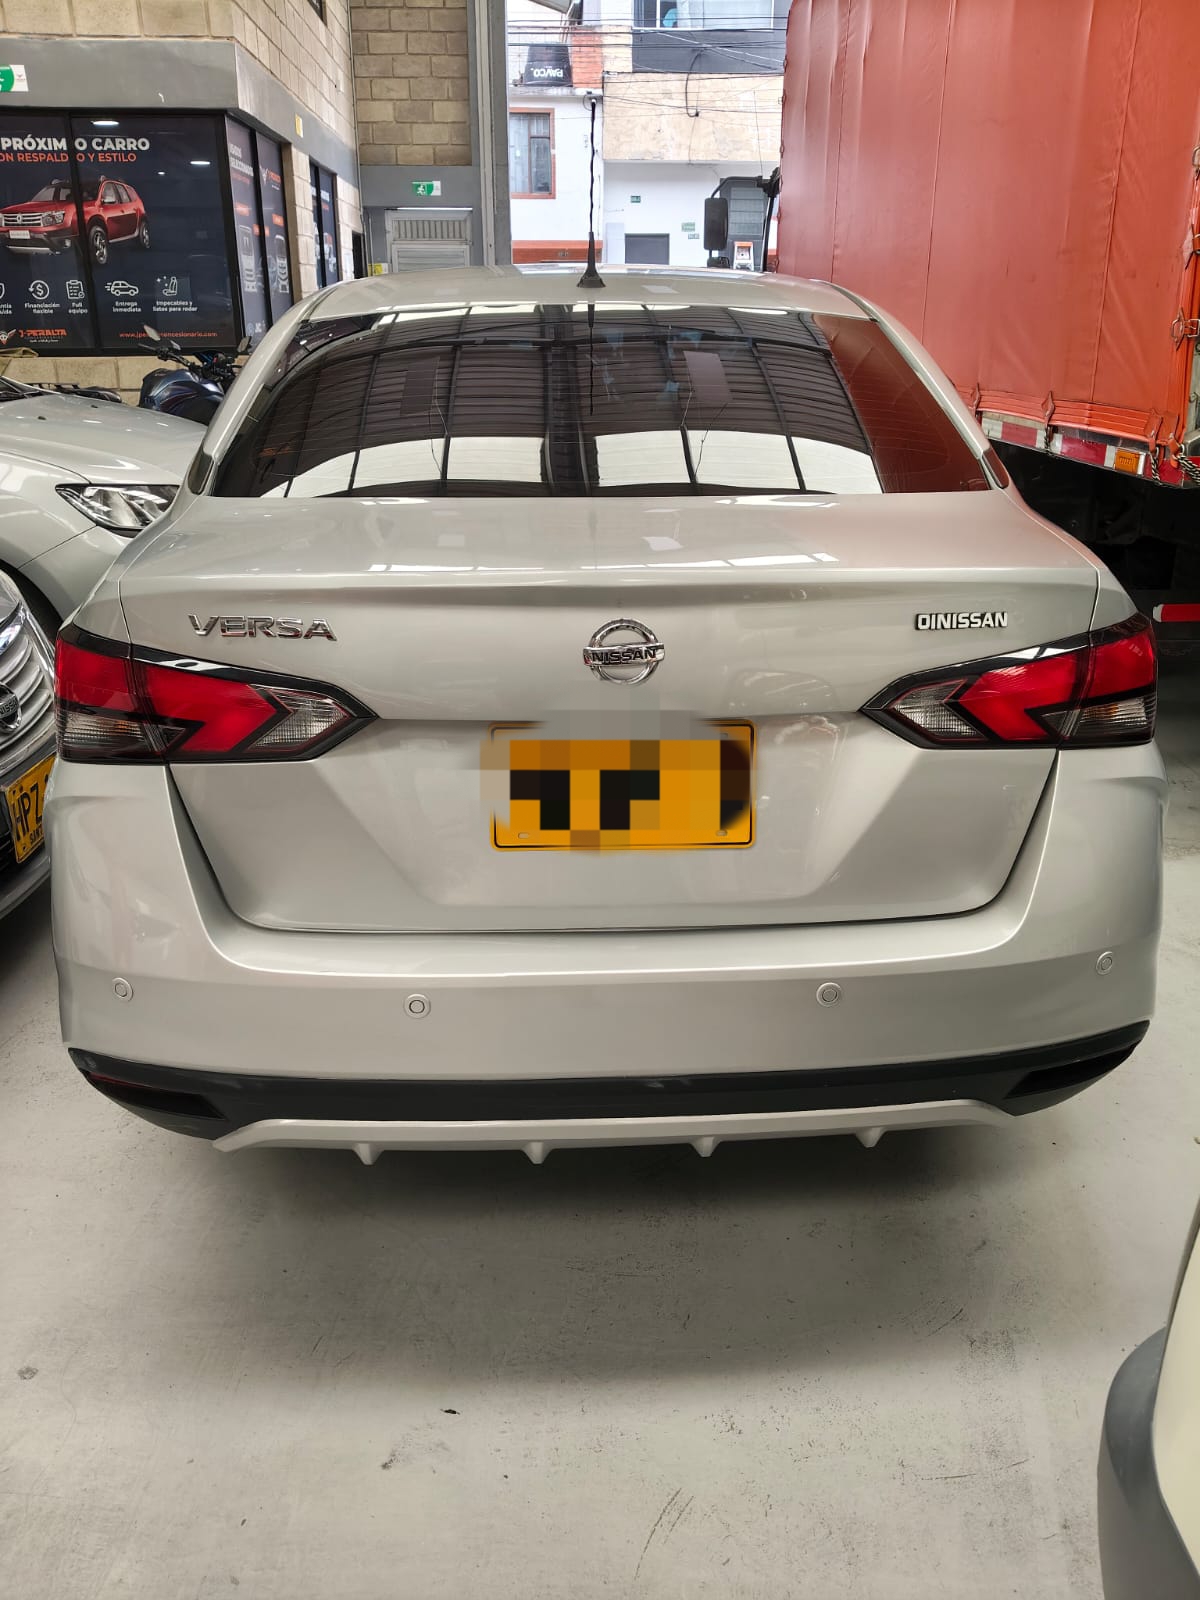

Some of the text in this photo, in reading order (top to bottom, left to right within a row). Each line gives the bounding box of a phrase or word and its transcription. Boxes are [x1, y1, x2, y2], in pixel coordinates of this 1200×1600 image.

[91, 137, 150, 151] CARRO
[88, 153, 95, 162] Y
[98, 153, 137, 162] ESTILO
[188, 614, 337, 641] VERSA
[592, 648, 657, 664] NISSAN
